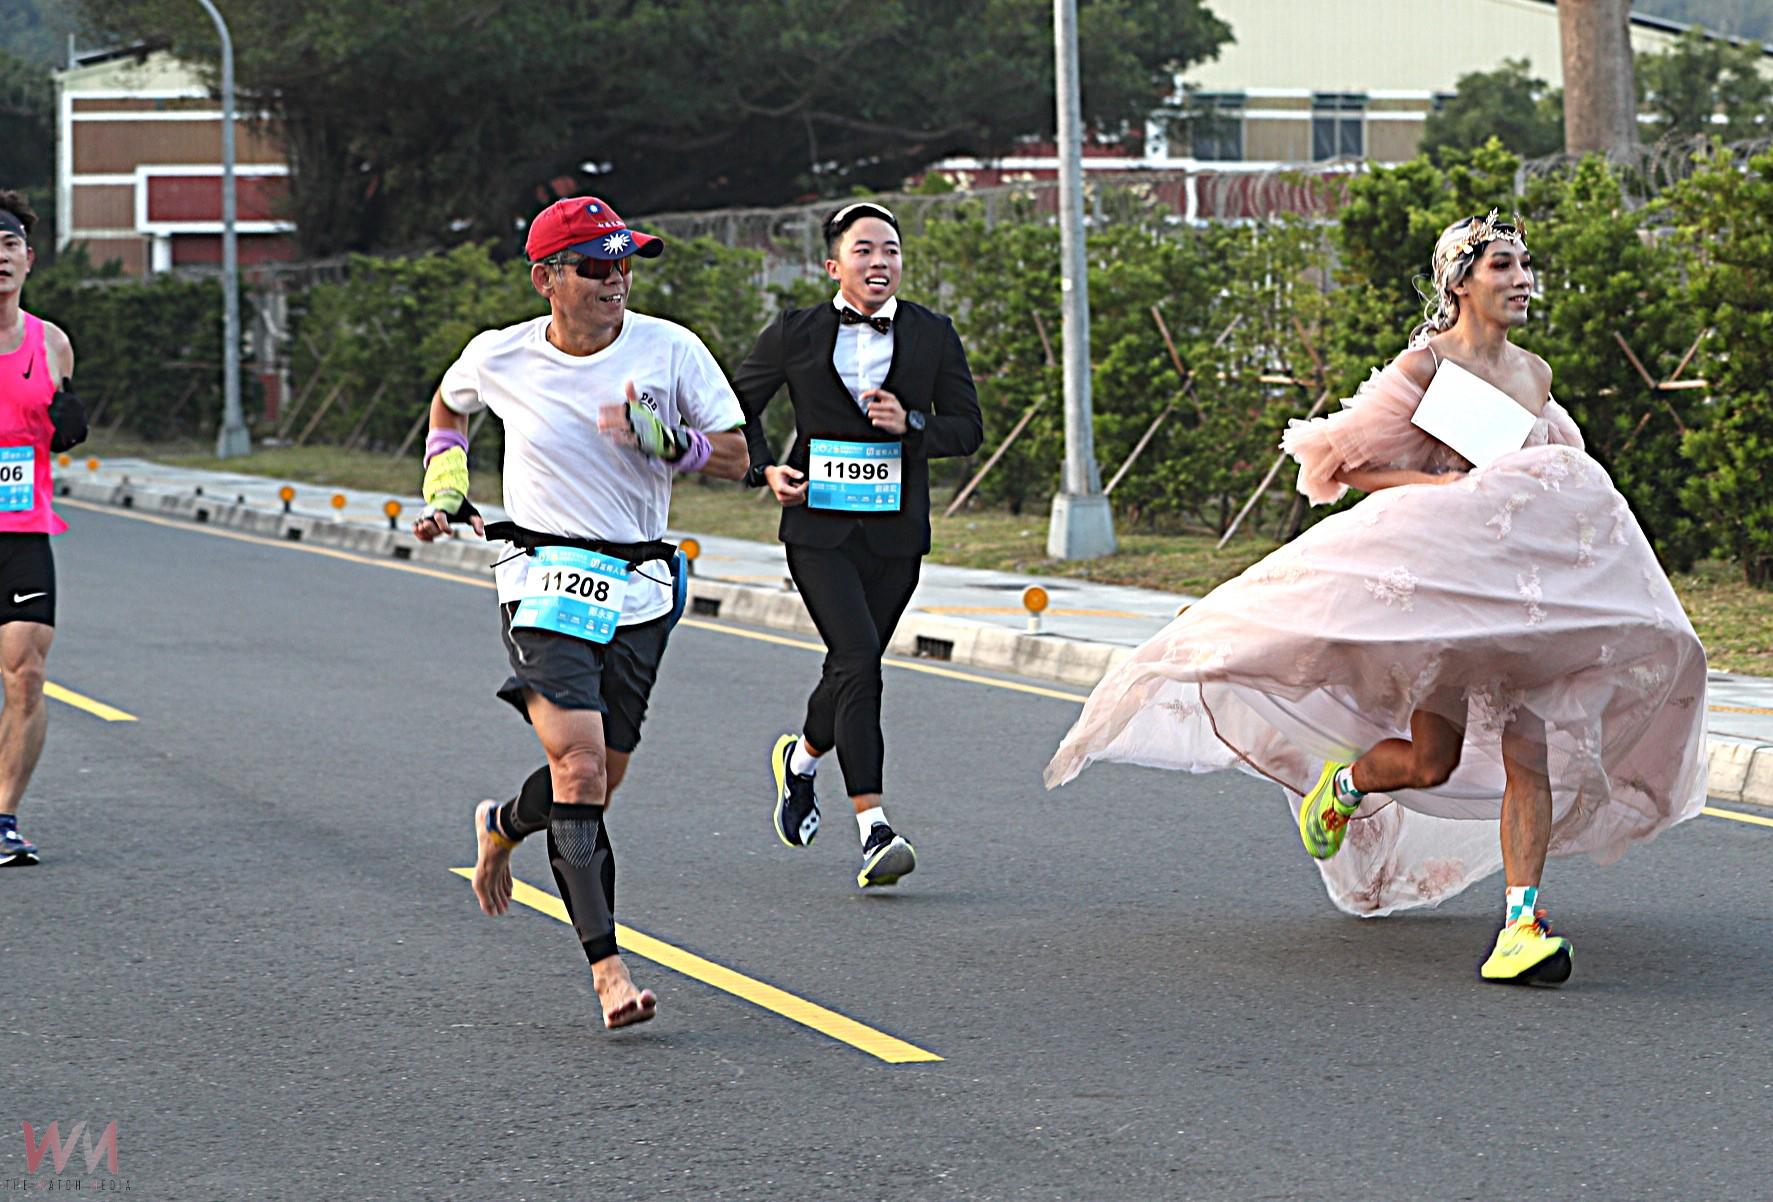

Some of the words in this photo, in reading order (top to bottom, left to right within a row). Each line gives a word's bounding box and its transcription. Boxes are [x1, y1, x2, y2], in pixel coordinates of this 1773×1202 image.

[0, 466, 23, 482] 06
[823, 461, 889, 480] 11996
[541, 571, 610, 602] 11208
